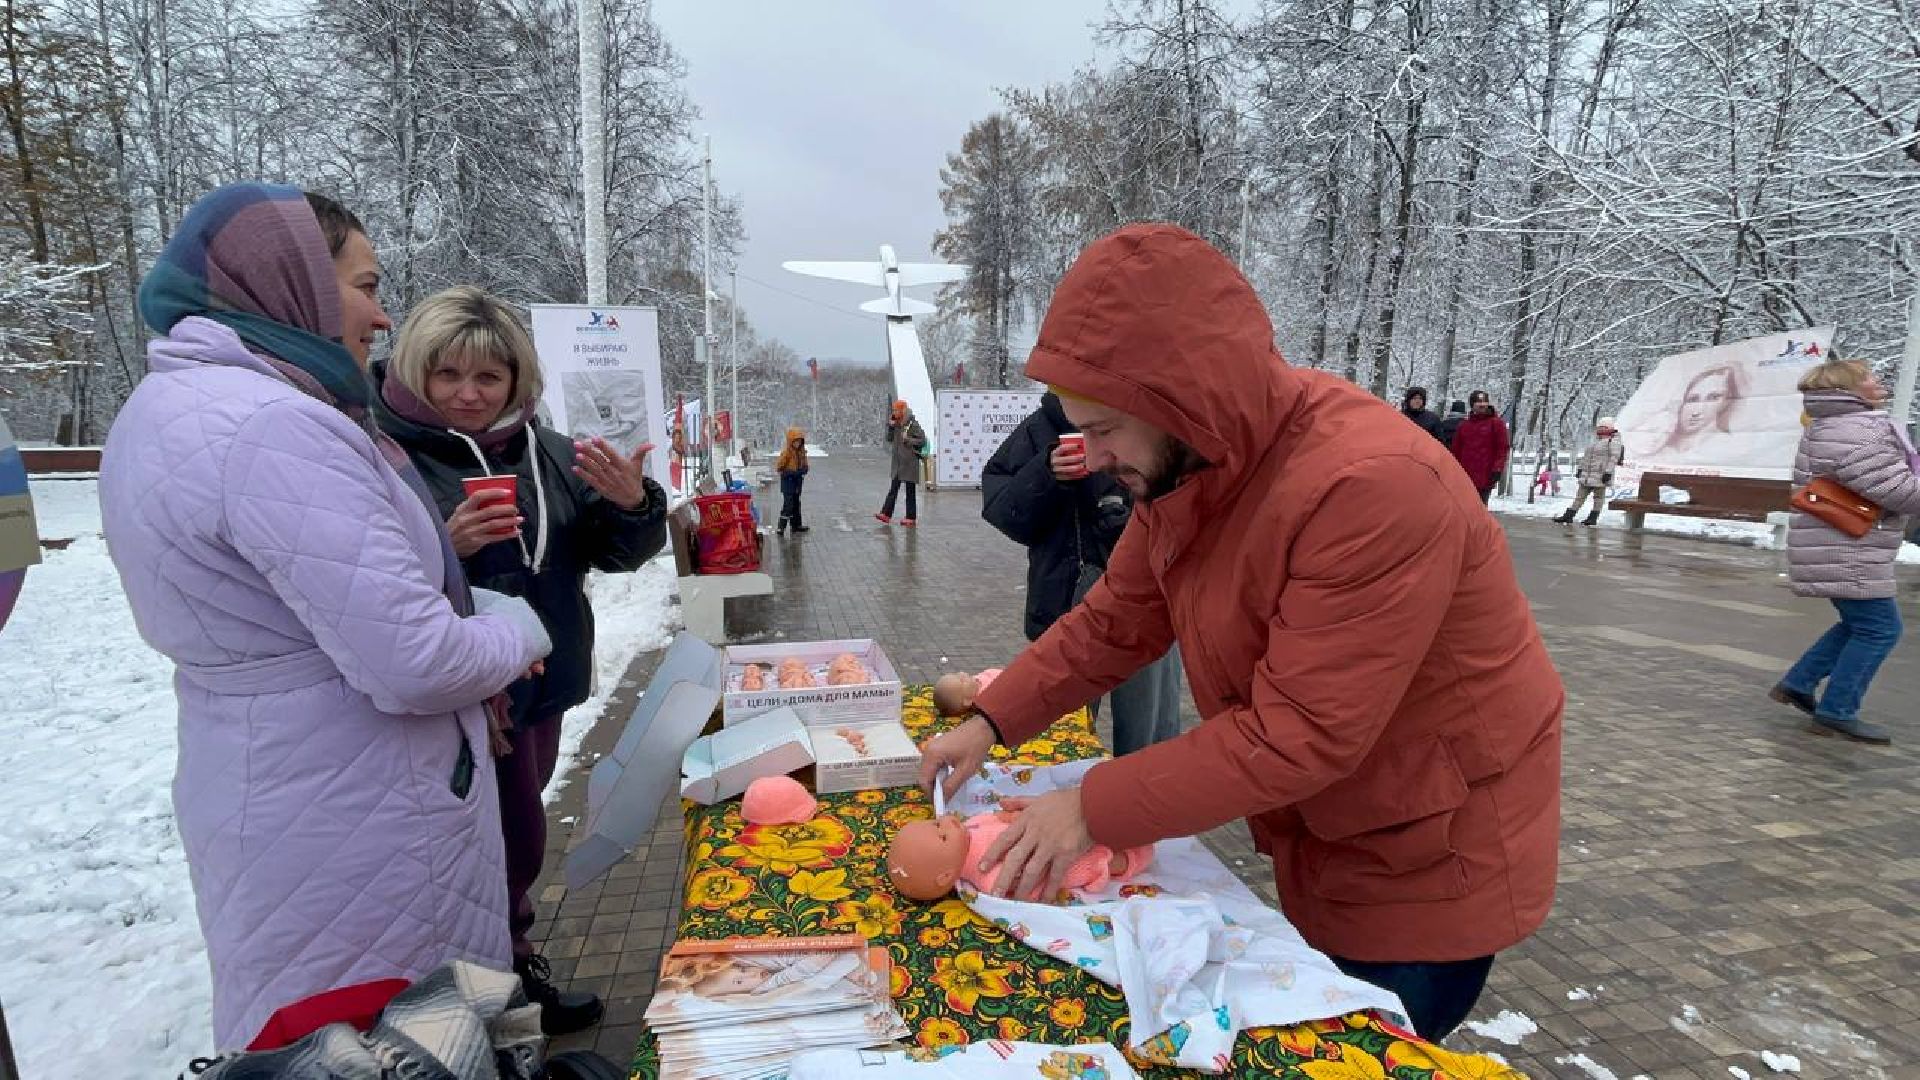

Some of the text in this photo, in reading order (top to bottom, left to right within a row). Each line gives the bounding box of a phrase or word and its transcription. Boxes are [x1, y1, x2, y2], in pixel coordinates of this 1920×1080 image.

[747, 688, 894, 709] ЦЕЛИ «ДОМА ДЛЯ МАМЫ»
